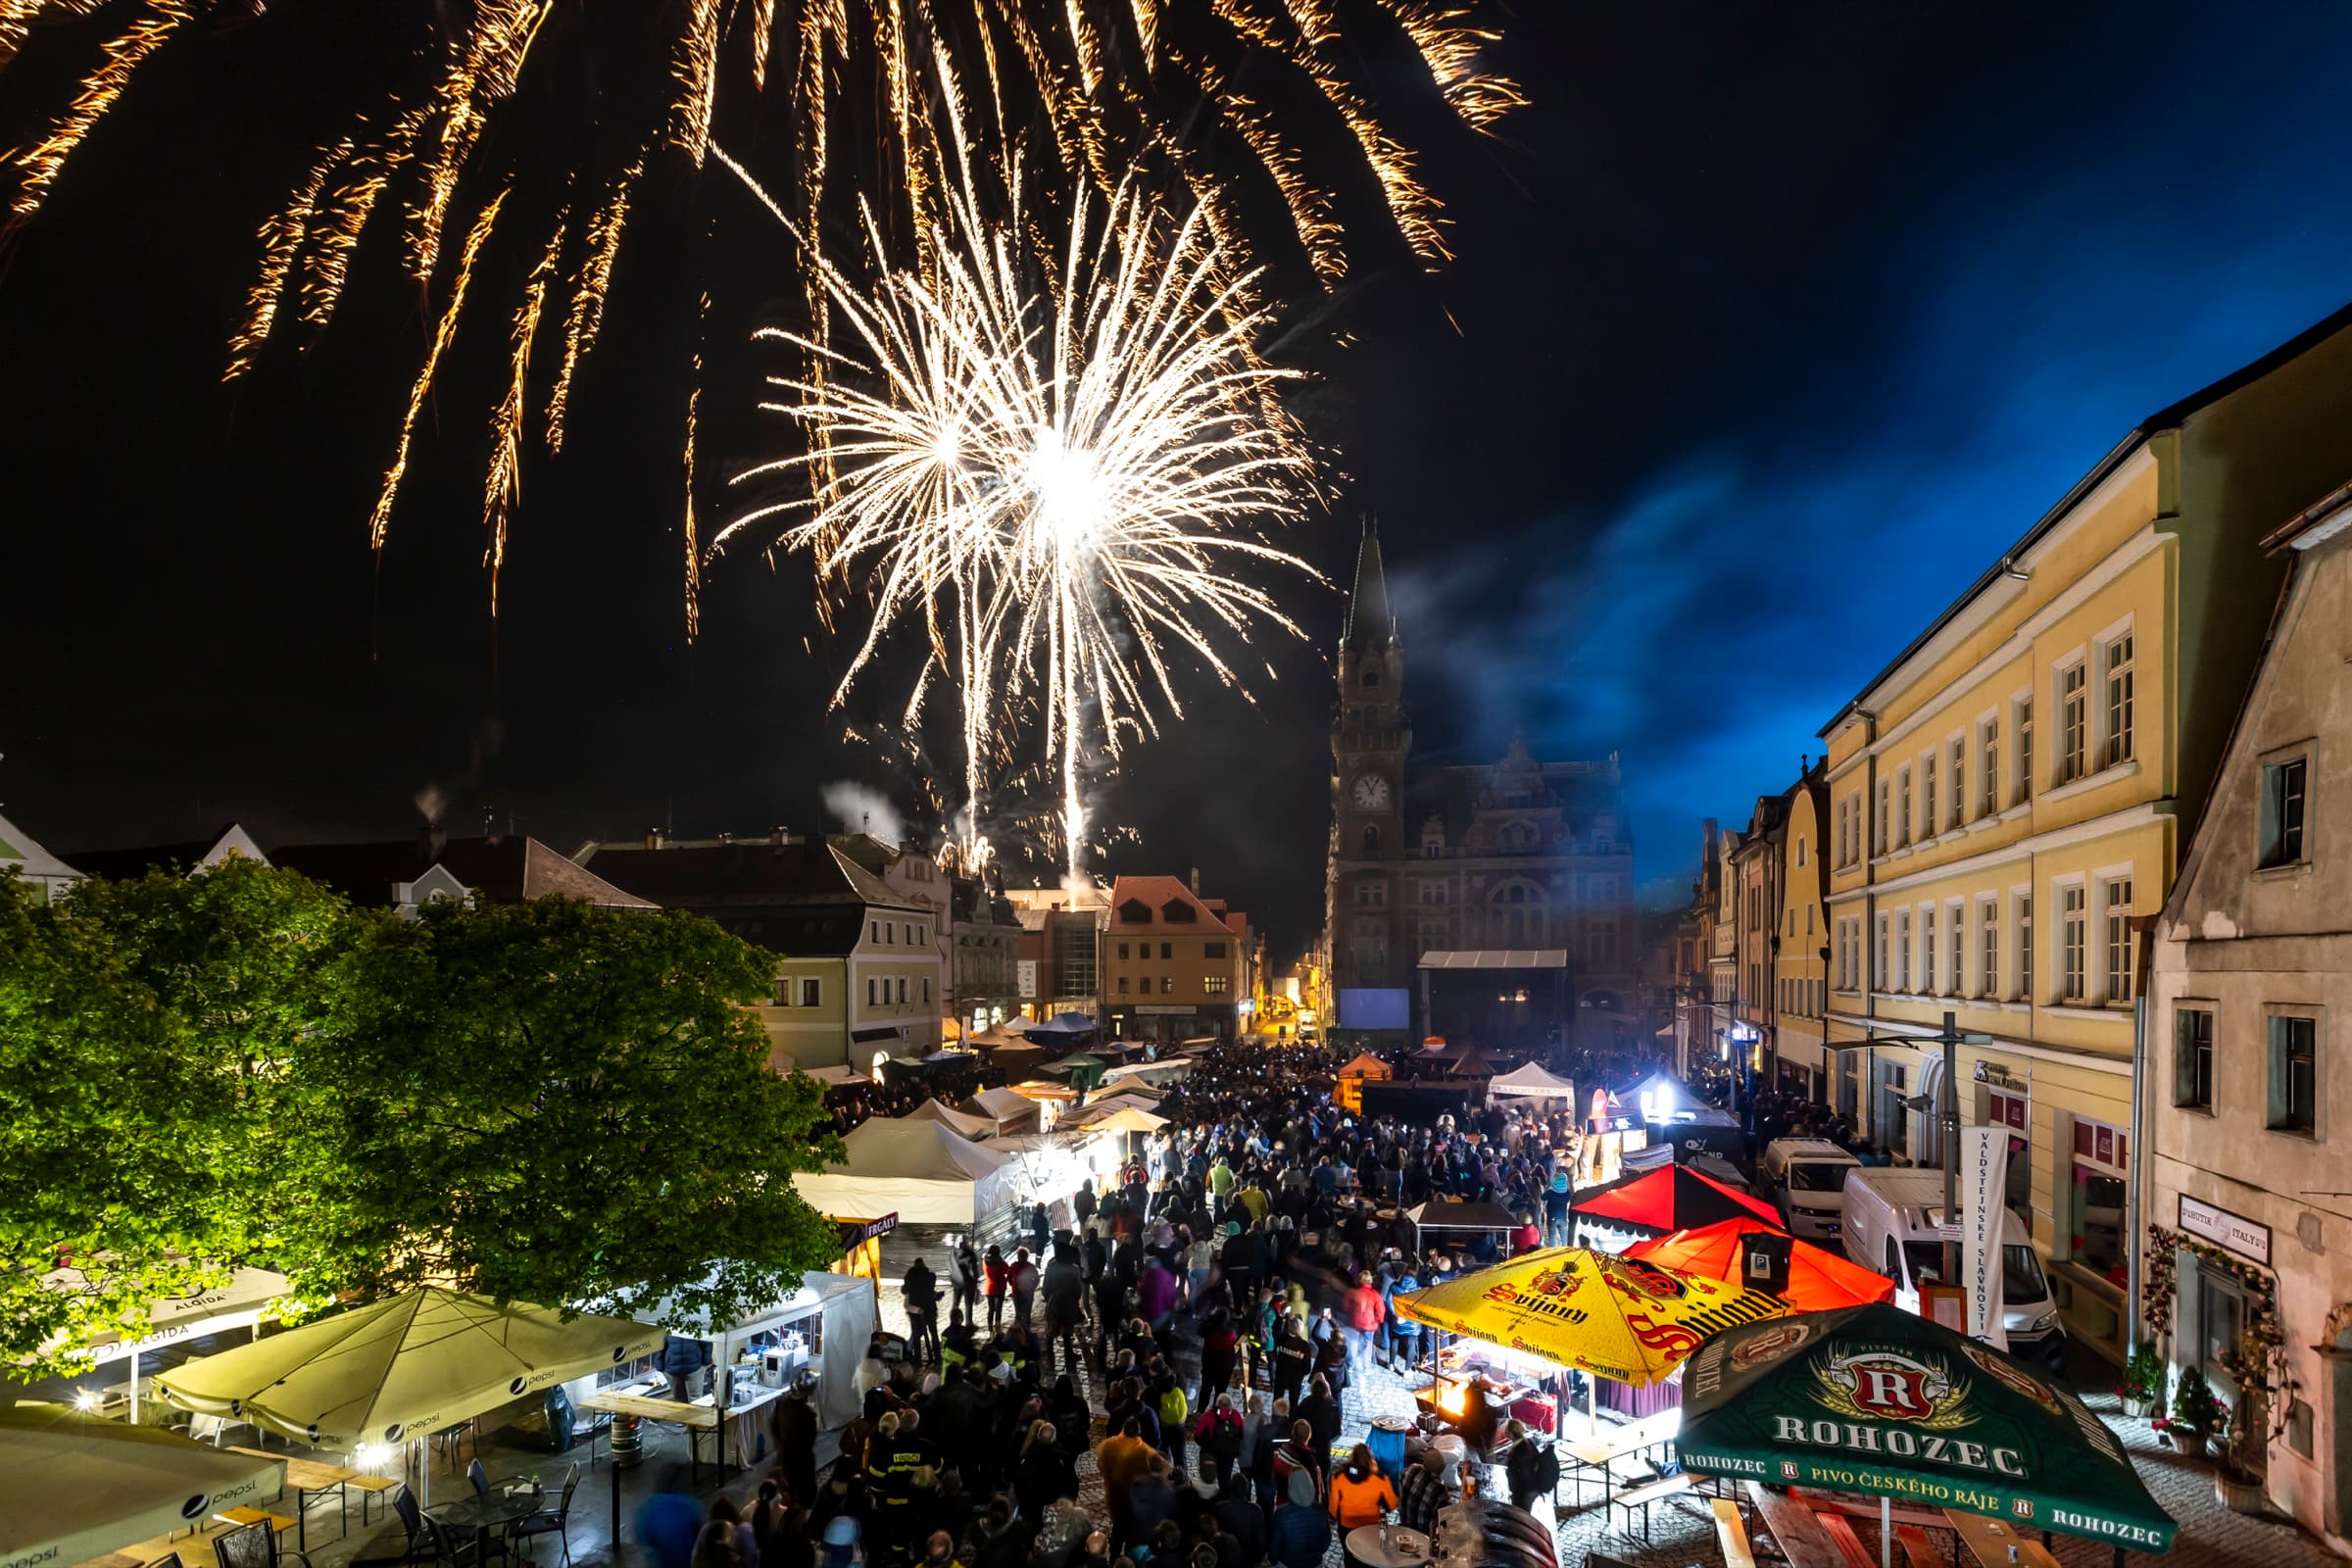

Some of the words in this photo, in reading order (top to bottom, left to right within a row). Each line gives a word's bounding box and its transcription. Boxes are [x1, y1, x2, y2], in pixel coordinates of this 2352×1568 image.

[868, 1216, 895, 1237] FRGÁLY
[2190, 1210, 2212, 1226] BUTIK
[2232, 1227, 2256, 1246] ITALY
[1977, 1248, 1986, 1331] SLAVNOSTI
[174, 1295, 224, 1311] ALGIDA
[1482, 1282, 1589, 1325] Svijany
[1454, 1319, 1498, 1344] Svijany
[627, 1341, 652, 1355] pepsi
[1512, 1336, 1561, 1361] Svijany
[528, 1370, 555, 1388] pepsi
[1575, 1354, 1629, 1381] Svijany
[1864, 1370, 1919, 1409] R
[406, 1412, 440, 1434] pepsi
[1775, 1416, 2026, 1477] ROHOZEC
[1684, 1453, 1767, 1473] ROHOZEC
[212, 1480, 258, 1505] pepsi
[1810, 1468, 1854, 1485] PIVO
[1859, 1471, 1948, 1499] ČESKÉHO
[1955, 1485, 1999, 1510] RÁJE
[2052, 1508, 2163, 1546] ROHOZEC
